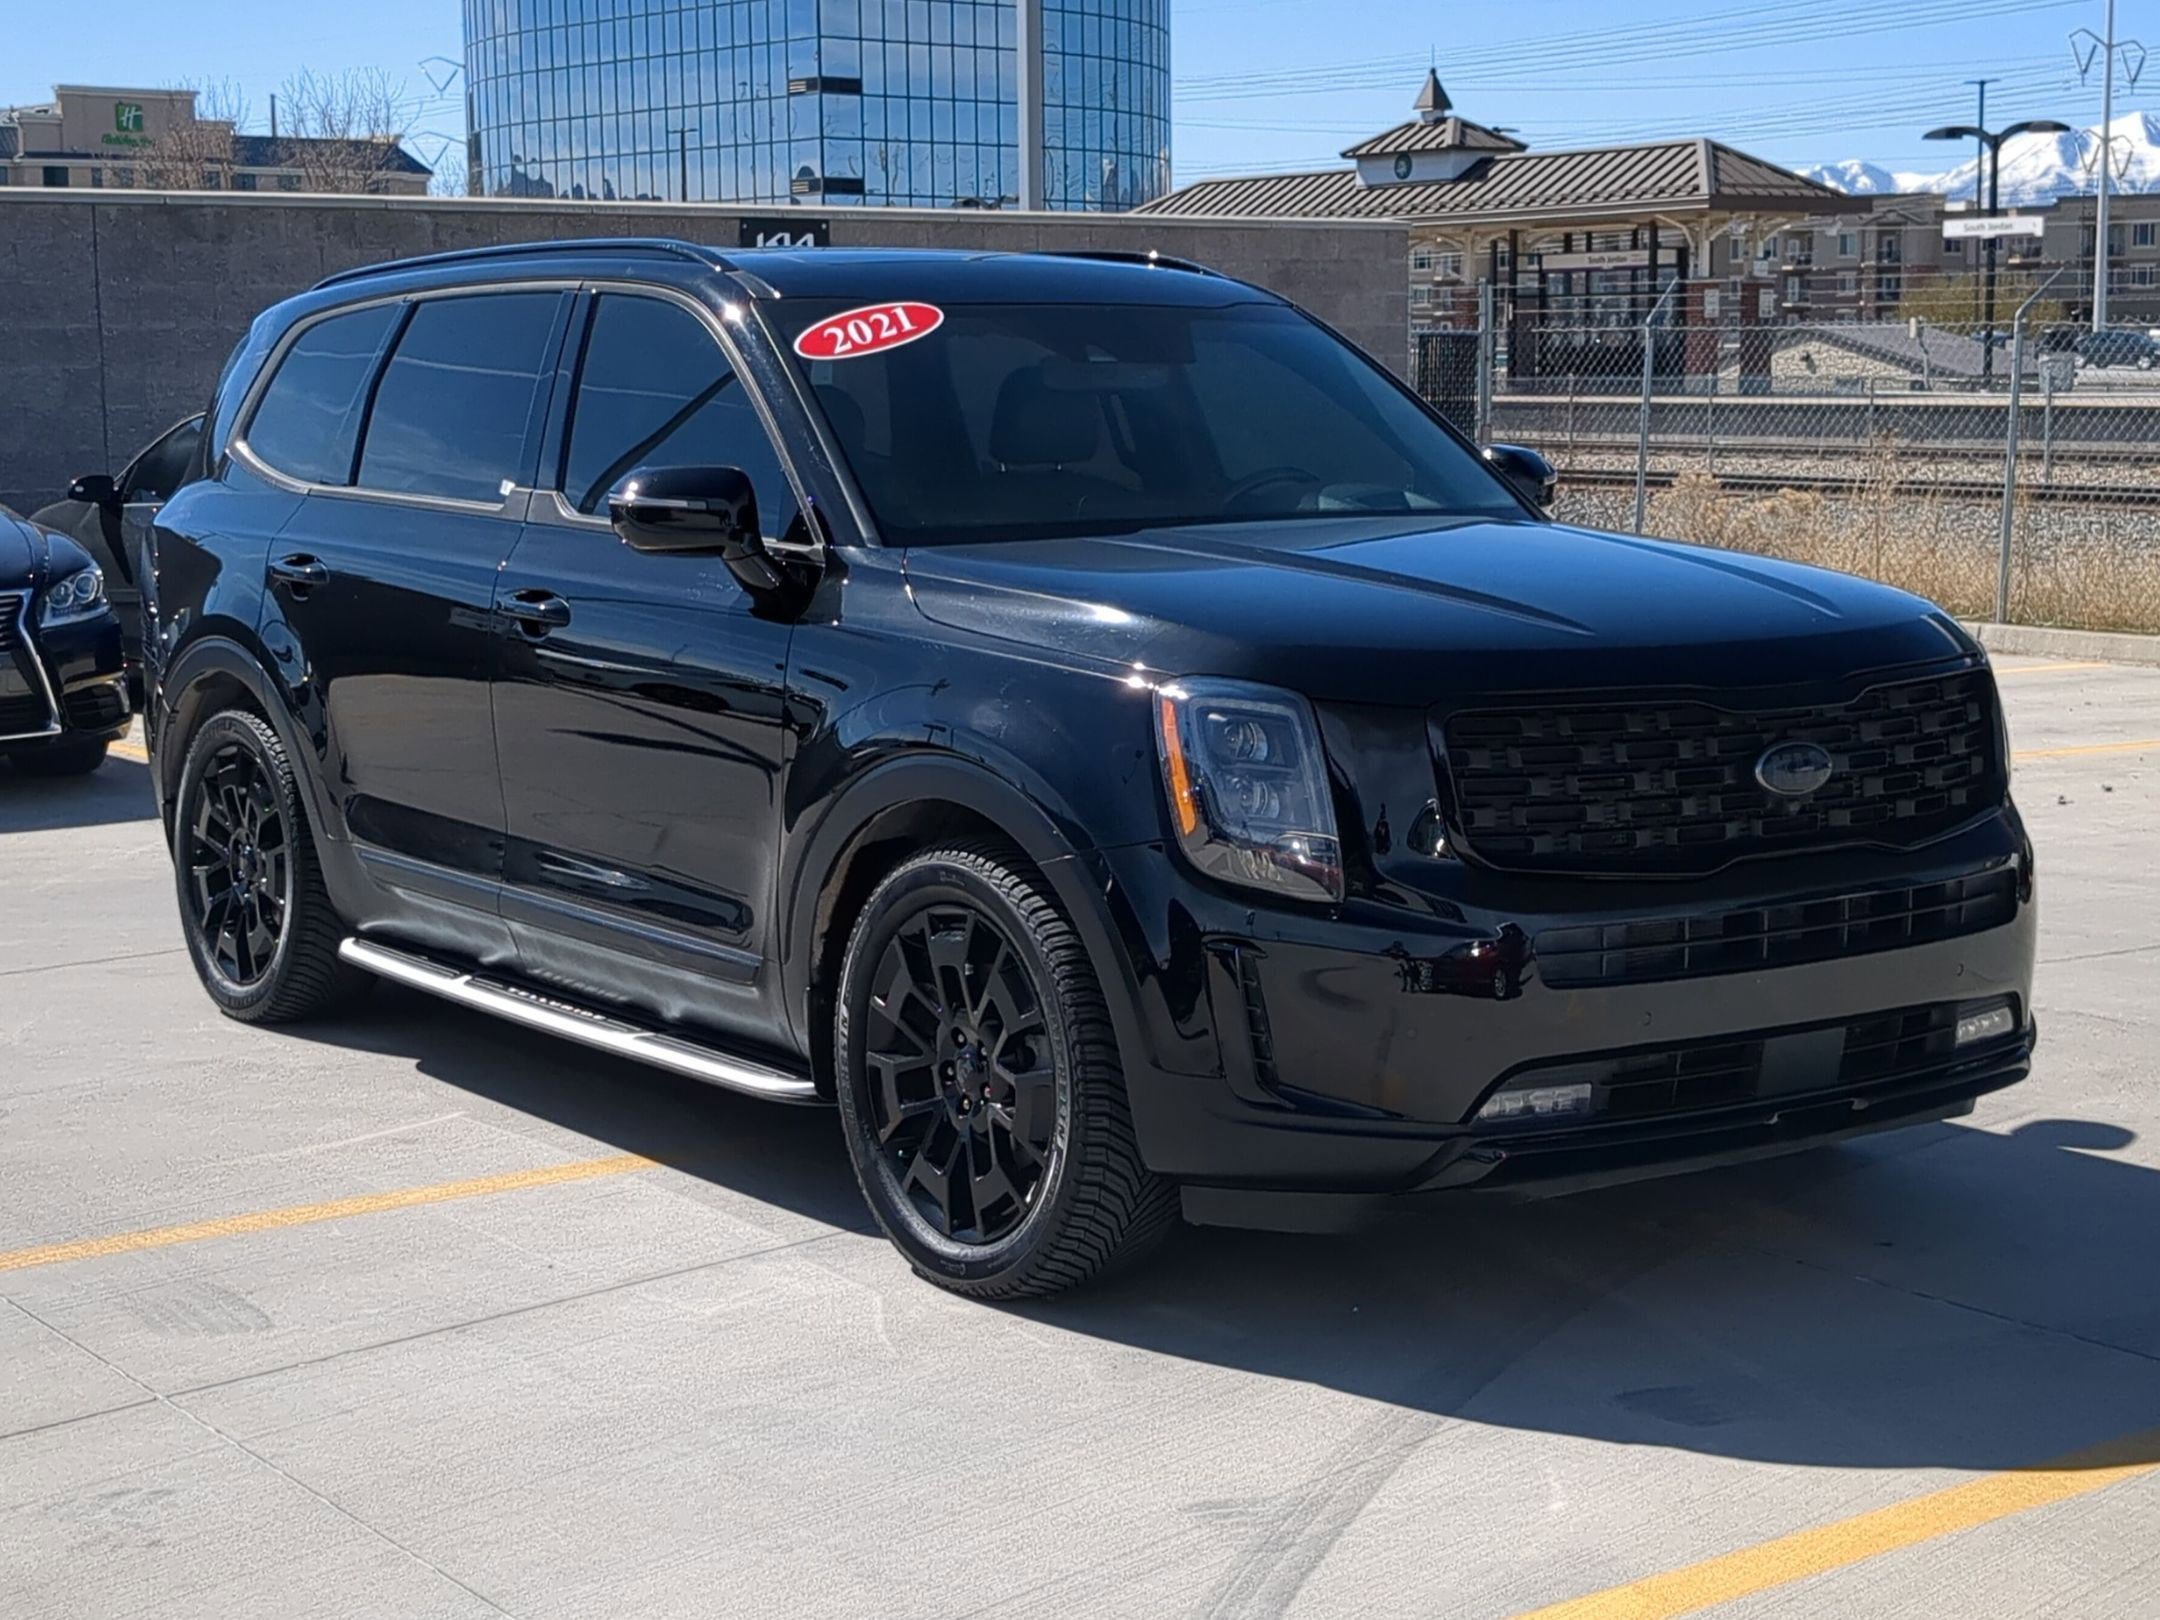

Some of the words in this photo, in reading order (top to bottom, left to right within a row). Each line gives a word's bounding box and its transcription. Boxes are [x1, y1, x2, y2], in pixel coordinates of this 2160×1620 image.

[1963, 222, 1987, 232] South
[1988, 221, 2013, 231] Jordan
[1587, 256, 1606, 264] South
[1606, 255, 1628, 264] Jordan
[823, 306, 918, 354] 2021
